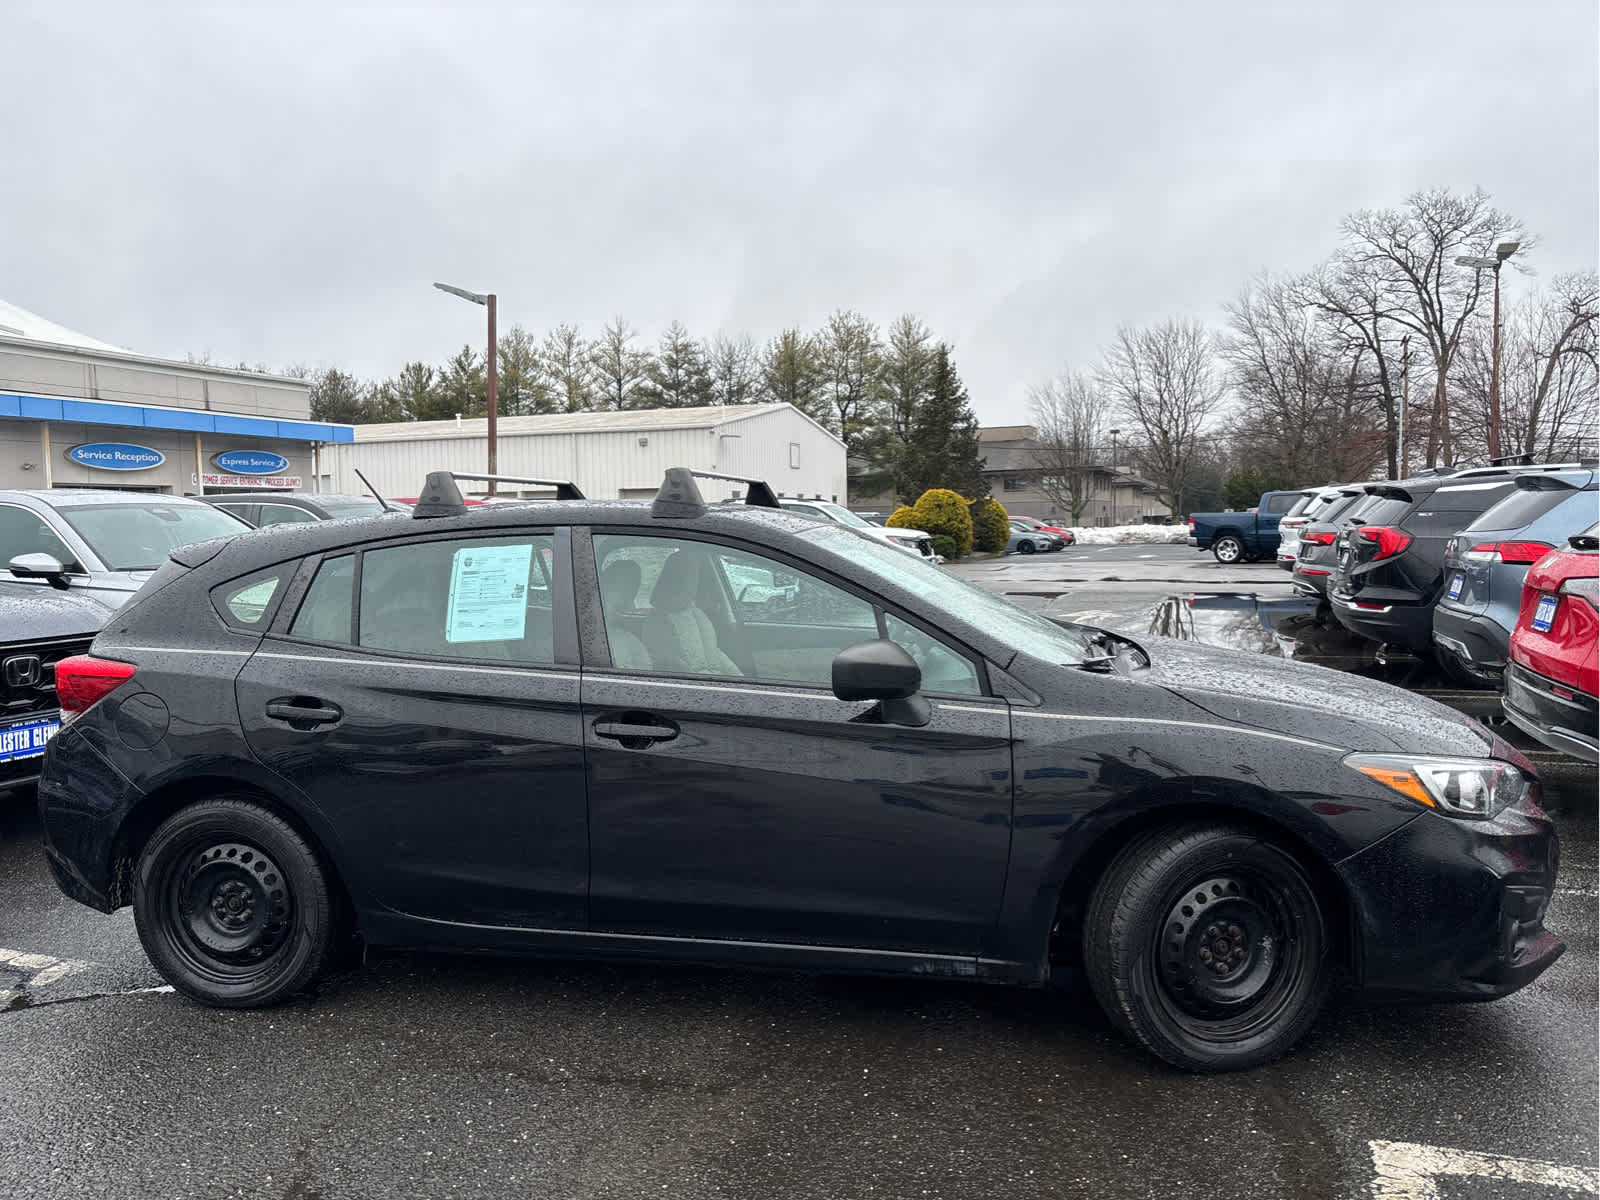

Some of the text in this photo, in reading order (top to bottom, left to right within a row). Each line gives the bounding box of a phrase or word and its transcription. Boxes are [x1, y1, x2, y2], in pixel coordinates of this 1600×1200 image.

[77, 449, 159, 463] Service Reception
[221, 457, 275, 467] Express Service
